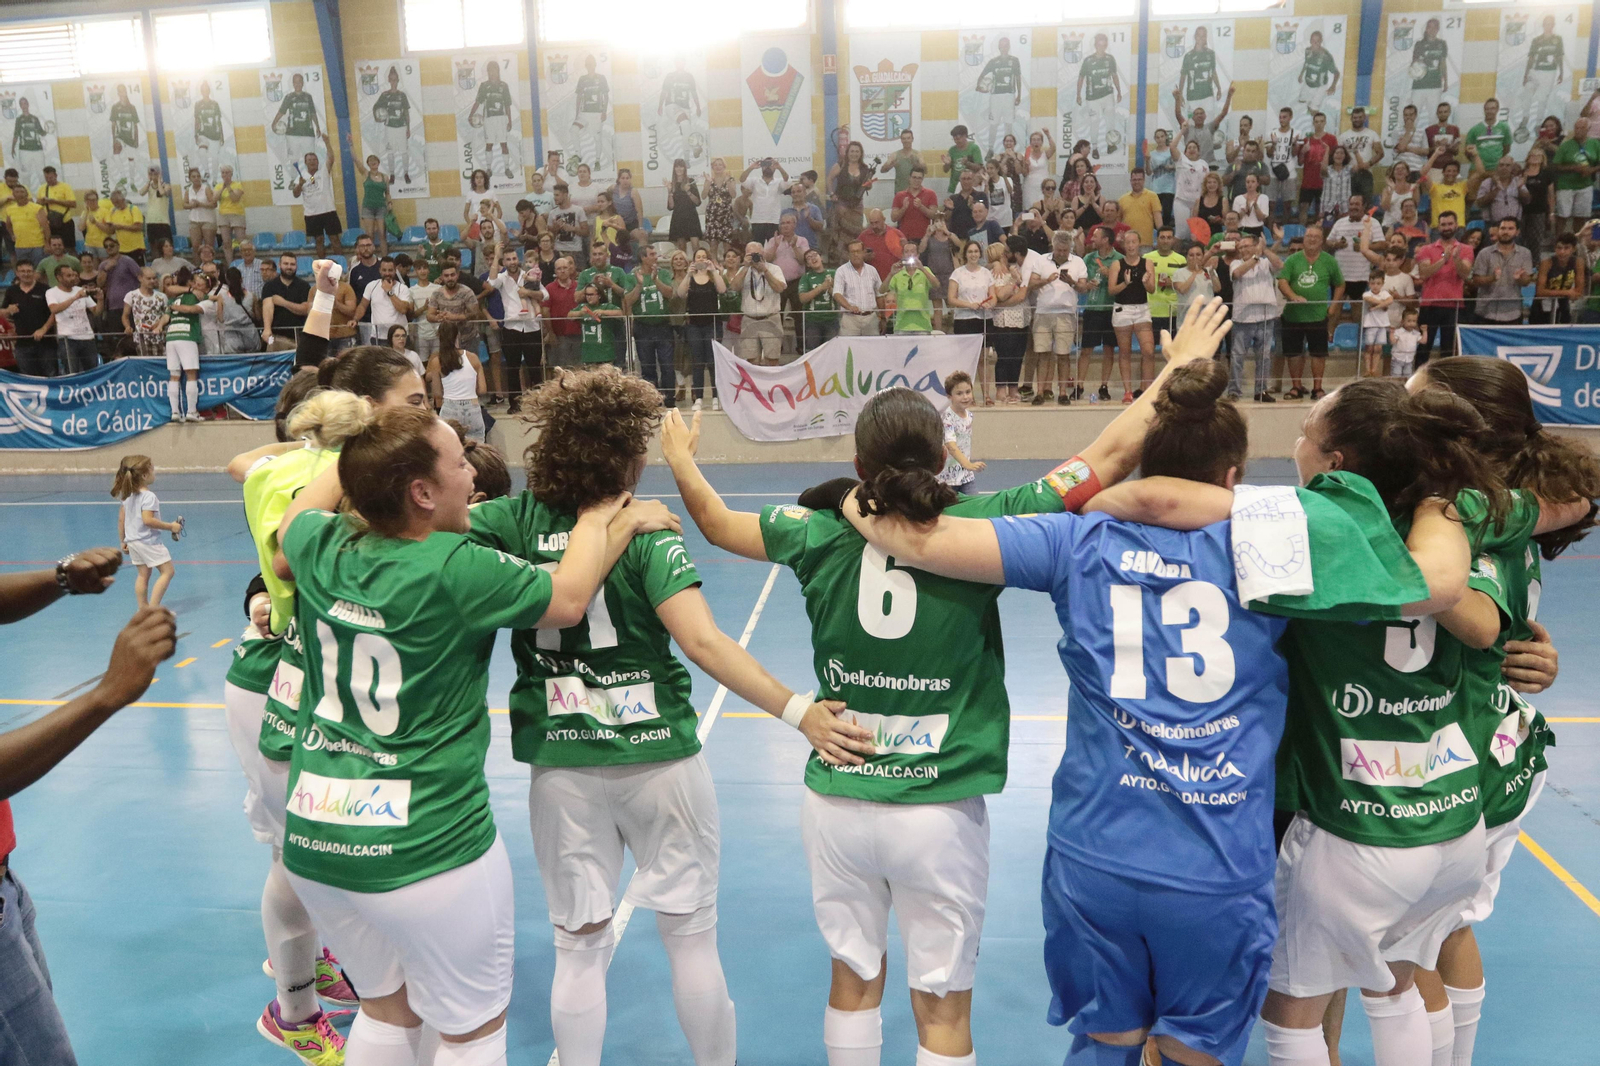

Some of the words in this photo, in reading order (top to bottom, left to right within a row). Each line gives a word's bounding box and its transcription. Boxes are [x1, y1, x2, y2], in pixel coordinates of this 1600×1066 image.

[1333, 23, 1342, 34] 8
[1446, 17, 1462, 29] 21
[1564, 13, 1574, 24] 4
[1019, 34, 1028, 44] 6
[1110, 32, 1126, 42] 11
[1216, 26, 1232, 37] 12
[503, 59, 510, 70] 7
[600, 52, 608, 62] 5
[304, 72, 320, 82] 13
[404, 64, 412, 75] 9
[43, 91, 48, 100] 1
[127, 84, 140, 94] 14
[215, 81, 222, 90] 2
[1059, 111, 1074, 159] LORENA
[647, 124, 658, 171] OGALLA
[462, 142, 474, 180] CLARA
[100, 158, 110, 198] MARINA
[273, 164, 284, 190] KRIS
[58, 374, 169, 406] Diputación
[62, 414, 88, 436] de
[96, 408, 154, 434] Cádiz
[857, 541, 918, 640] 6
[328, 600, 386, 629] OGALLA
[1110, 581, 1236, 704] 13
[314, 618, 403, 736] 10
[840, 671, 951, 692] belcónobras
[1139, 713, 1240, 740] belcónobras
[292, 785, 402, 820] Andalucía
[288, 832, 393, 857] AYTO.GUADALCACIN
